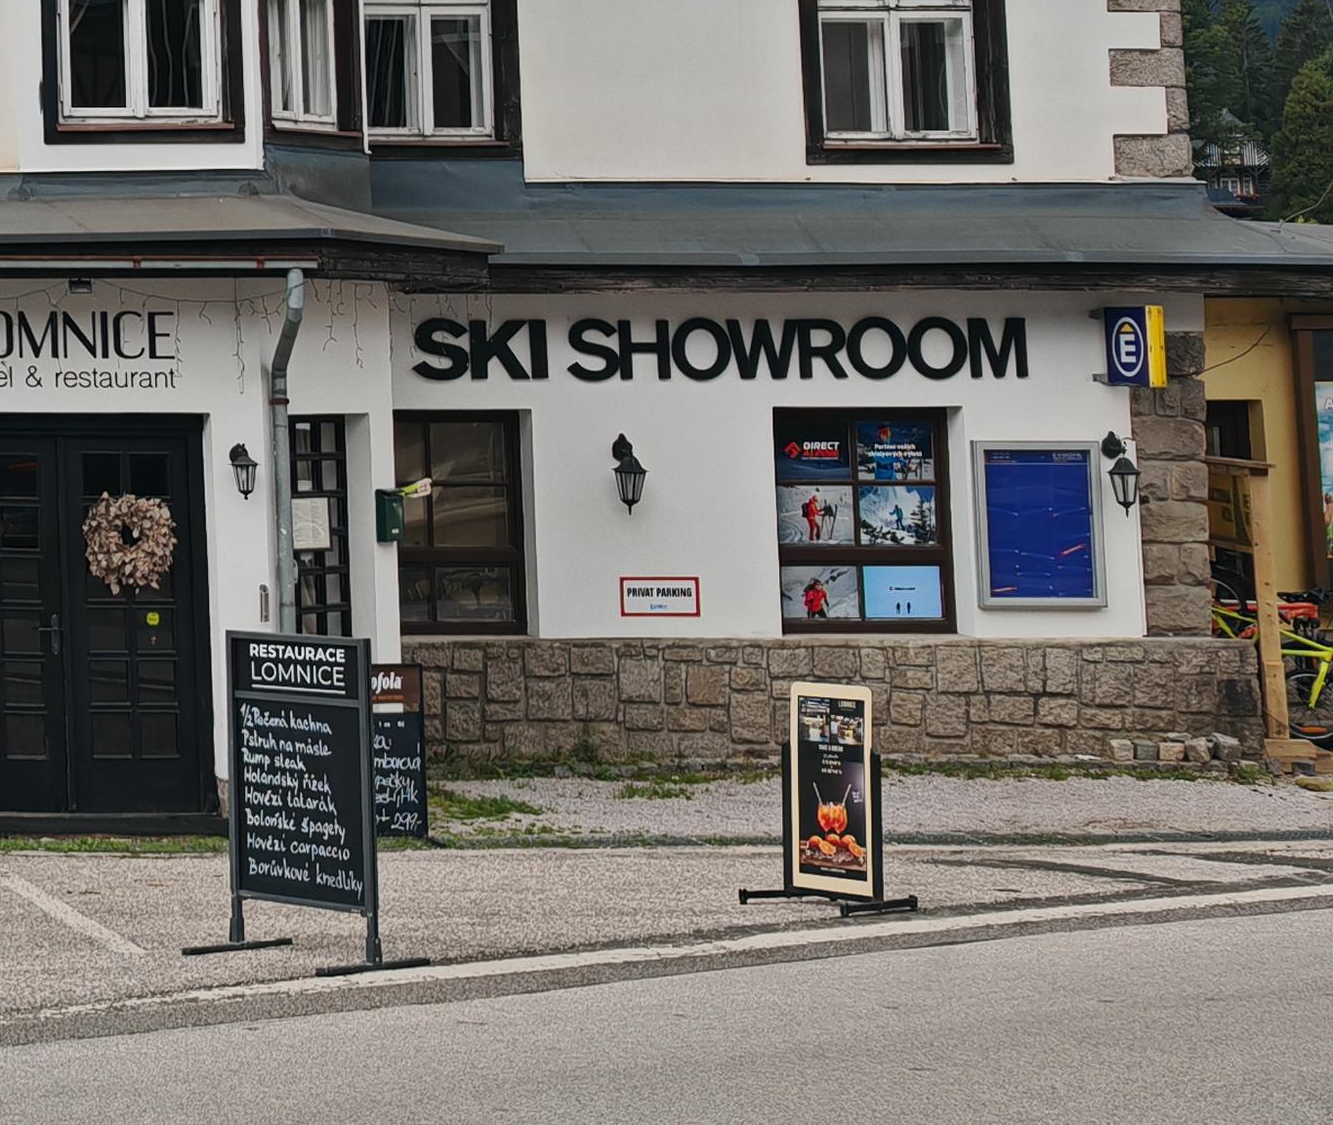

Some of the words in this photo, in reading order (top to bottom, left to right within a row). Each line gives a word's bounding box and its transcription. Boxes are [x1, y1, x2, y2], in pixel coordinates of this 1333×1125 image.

[412, 317, 549, 381] SKI
[566, 317, 1029, 381] SHOWROOM
[25, 365, 43, 388] &
[55, 367, 176, 389] restaurant
[803, 442, 840, 451] DIRECT
[626, 587, 654, 598] PRIVAT
[656, 587, 693, 598] PARKING
[249, 643, 346, 663] RESTAURACE
[251, 661, 345, 686] LOMNICE
[371, 671, 402, 695] ofola
[289, 710, 332, 735] kachna
[241, 747, 271, 771] Rump
[279, 739, 293, 752] na
[295, 738, 332, 756] másle
[244, 766, 299, 794] Holandský
[244, 786, 282, 806] Hovězí
[301, 816, 345, 845] špagety
[247, 832, 286, 852] Hovězí
[290, 841, 350, 861] carpaccio
[248, 857, 311, 882] Borůvkové
[316, 862, 363, 901] knedlíky
